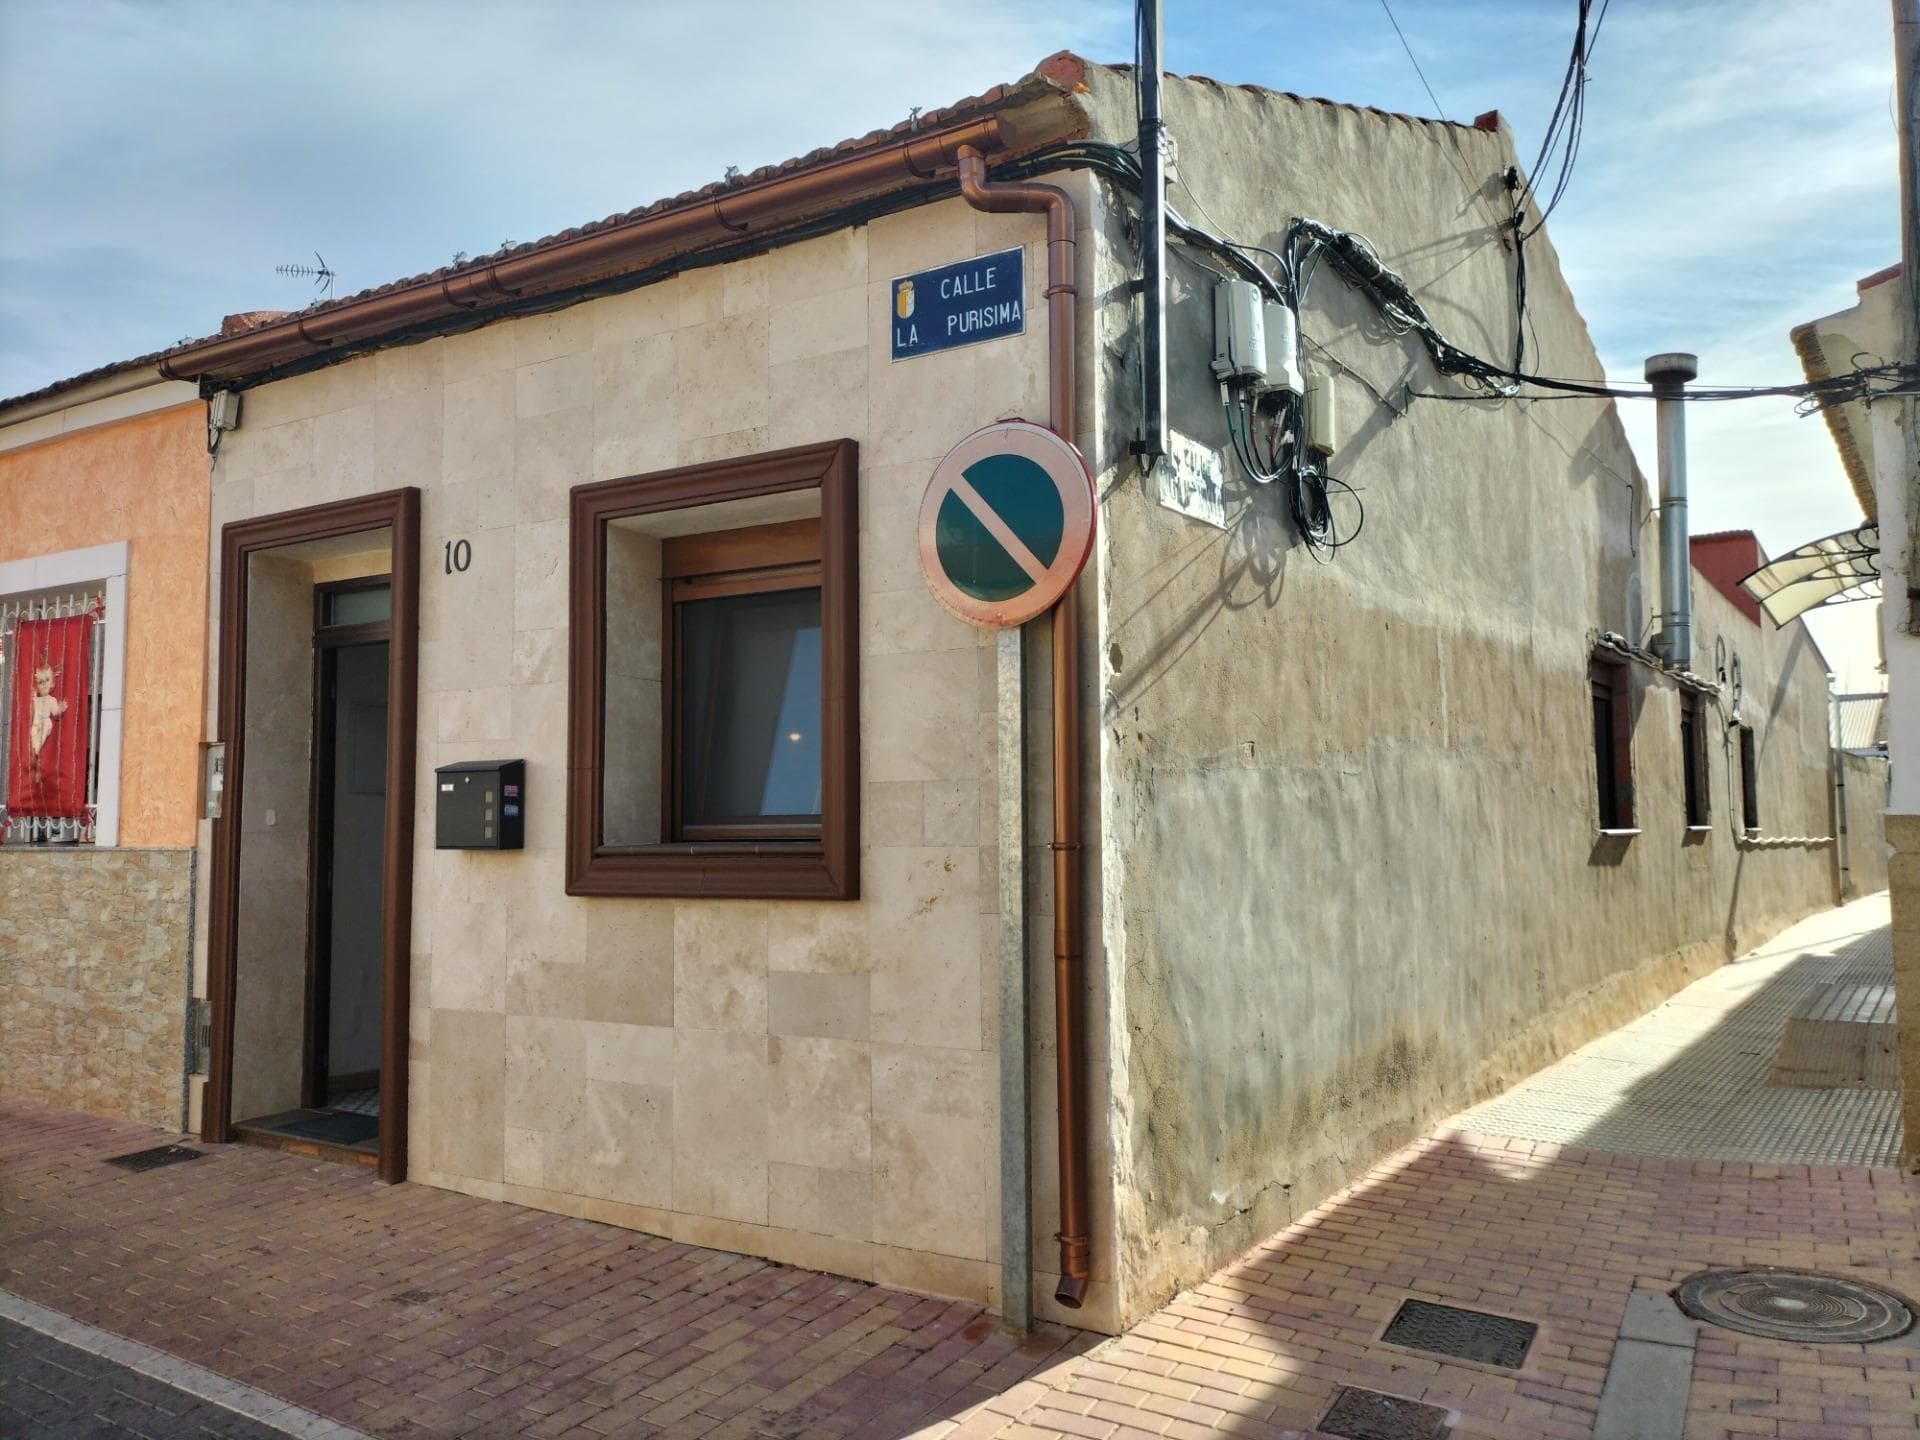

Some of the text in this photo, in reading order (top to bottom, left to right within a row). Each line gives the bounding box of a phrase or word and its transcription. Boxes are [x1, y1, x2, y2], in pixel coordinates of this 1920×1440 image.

[940, 267, 996, 299] CALLE
[896, 300, 1021, 347] LA PURISIMA
[445, 539, 472, 575] 10
